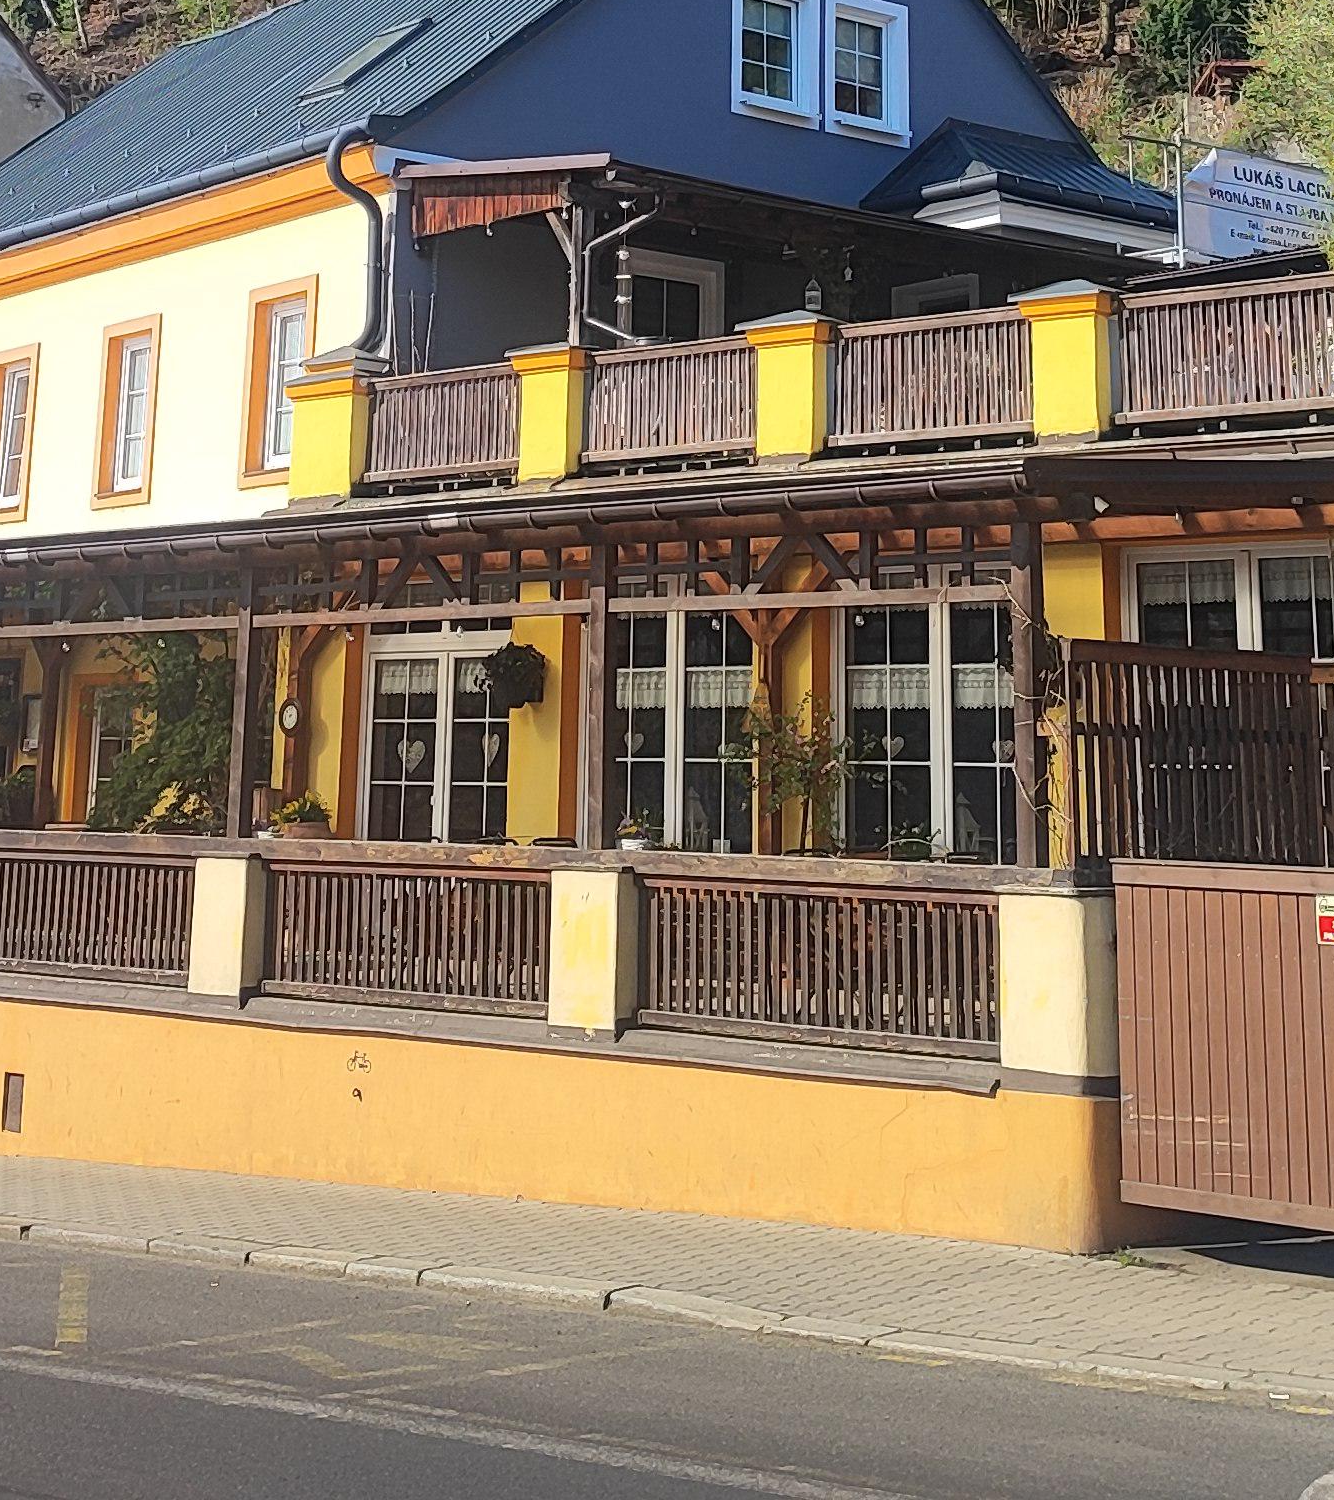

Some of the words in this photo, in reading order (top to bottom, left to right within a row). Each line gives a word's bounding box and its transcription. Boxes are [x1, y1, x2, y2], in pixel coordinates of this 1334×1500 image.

[1233, 165, 1284, 190] LUKÁŠ
[1288, 177, 1334, 200] LACIN
[1208, 187, 1272, 211] PRONÁJEM
[1275, 201, 1284, 214] A
